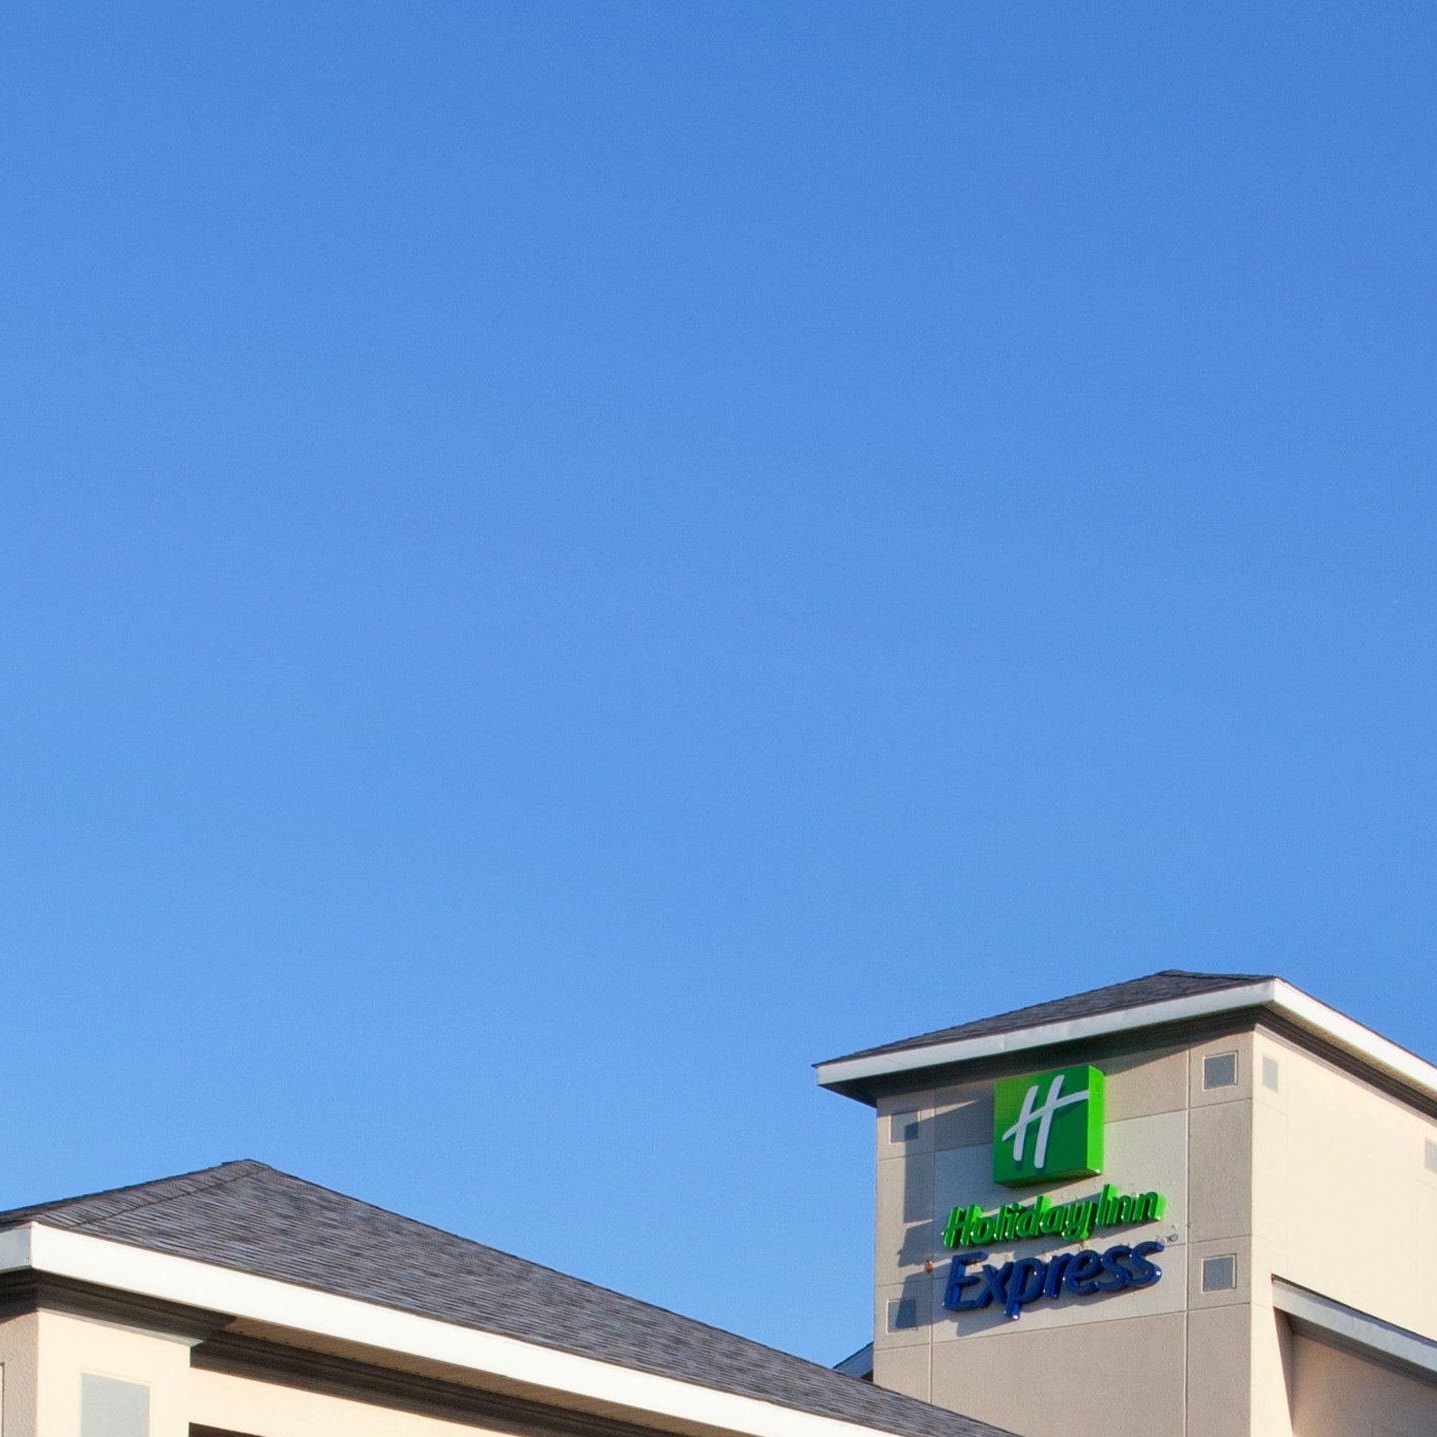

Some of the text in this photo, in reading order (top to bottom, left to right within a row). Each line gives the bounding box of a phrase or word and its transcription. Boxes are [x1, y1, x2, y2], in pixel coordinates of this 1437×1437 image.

[1002, 1074, 1089, 1169] H
[941, 1183, 1166, 1248] Holiday Inn
[942, 1240, 1165, 1320] Express
